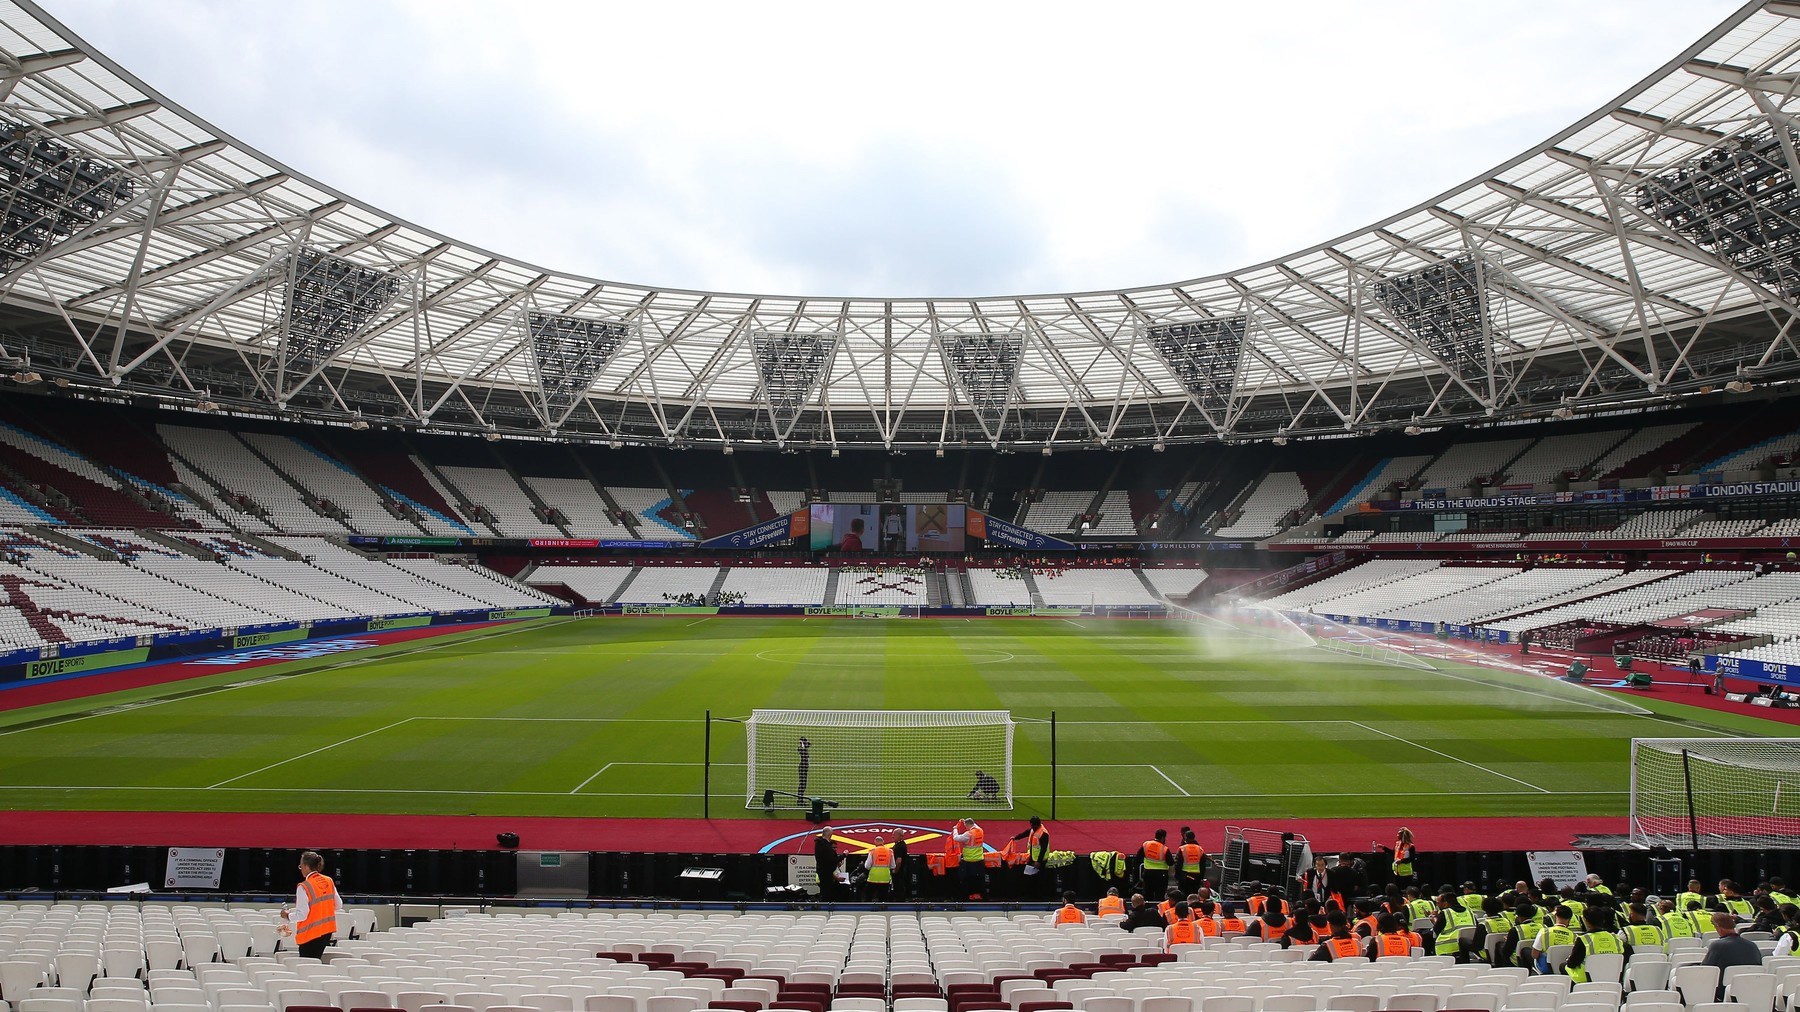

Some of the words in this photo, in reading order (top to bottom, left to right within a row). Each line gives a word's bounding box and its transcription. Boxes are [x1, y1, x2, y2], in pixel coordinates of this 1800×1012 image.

[1706, 484, 1752, 496] LONDON
[1755, 481, 1800, 494] STADIU
[1416, 500, 1434, 510] THIS
[1437, 500, 1444, 509] IS
[1446, 500, 1463, 508] THE
[1465, 498, 1506, 508] WORLD'S
[1507, 496, 1536, 506] STAGE
[742, 528, 756, 540] STAY
[757, 519, 788, 535] CONNECTED
[988, 520, 1002, 529] STAY
[1002, 524, 1033, 540] CONNECTED
[370, 621, 384, 630] BOYLE
[237, 636, 257, 647] BOYLE
[32, 660, 64, 676] BOYLE
[65, 658, 84, 667] SPORTS
[1718, 658, 1739, 667] BOYLE
[1763, 663, 1786, 674] BOYLE
